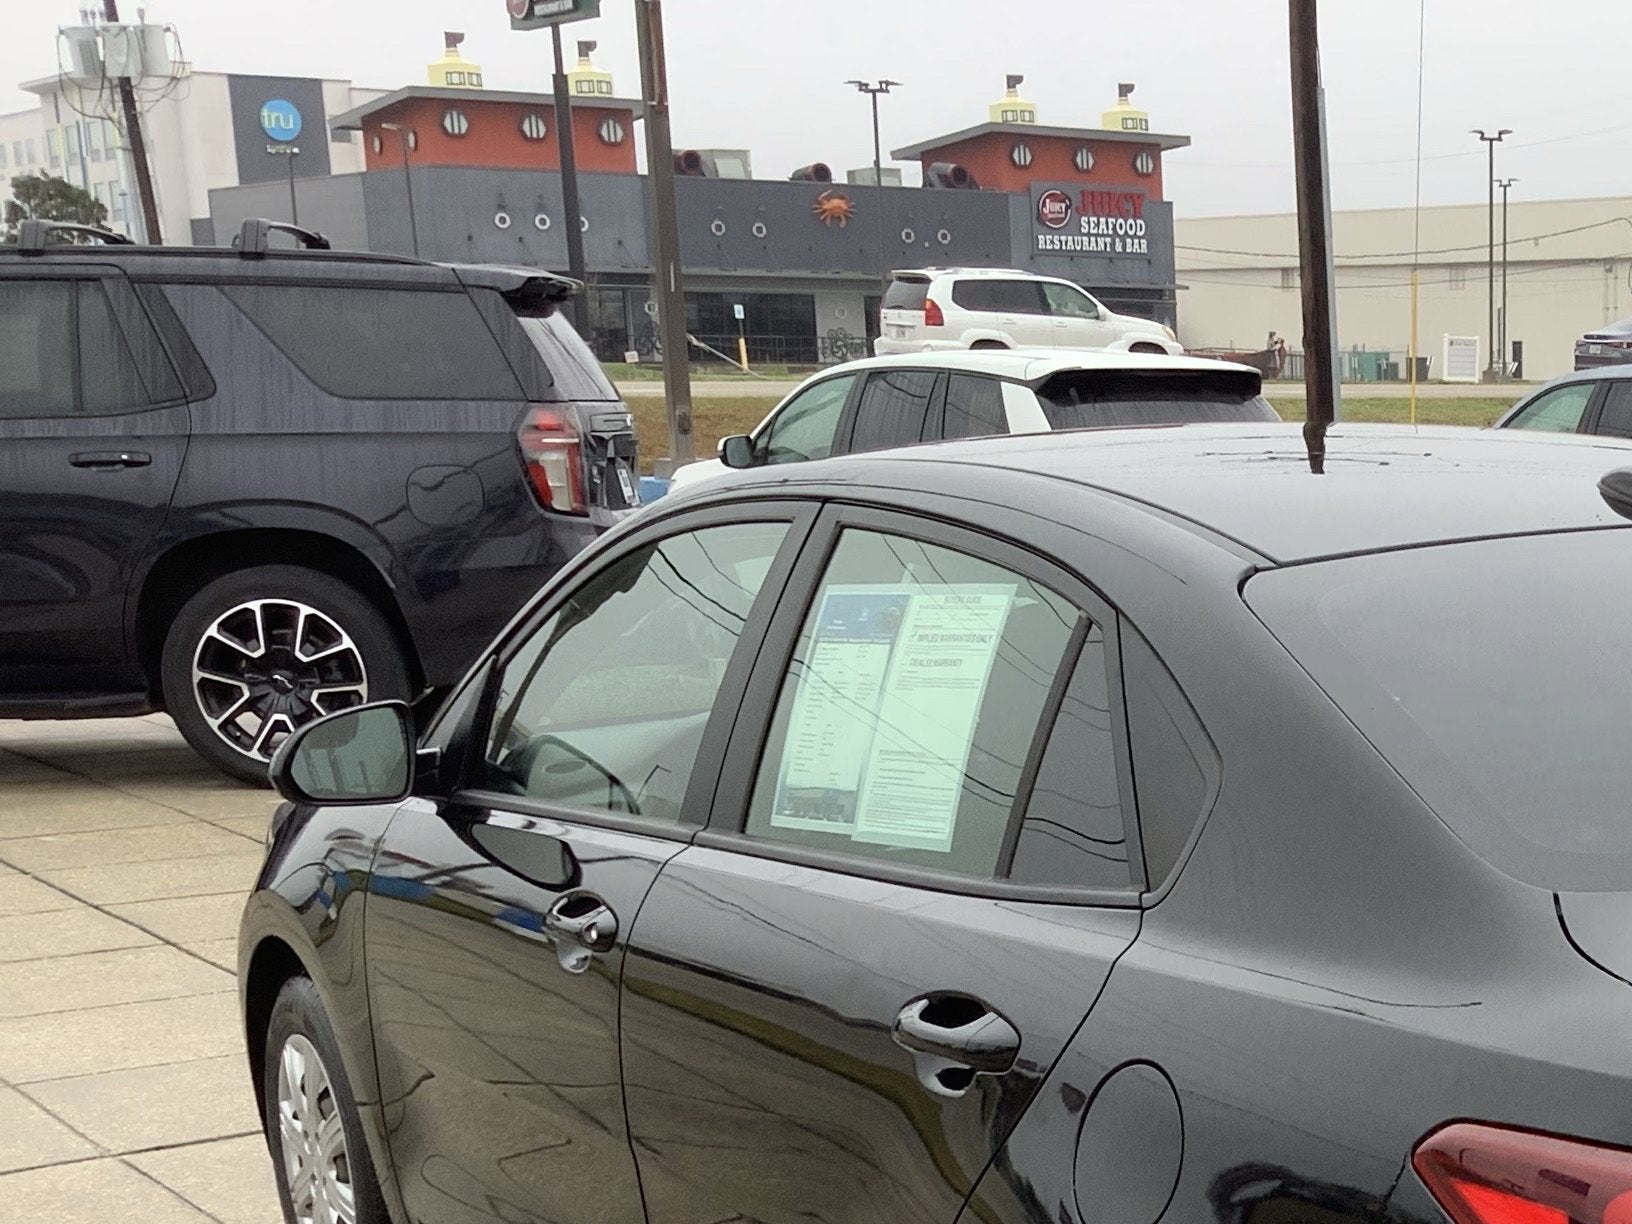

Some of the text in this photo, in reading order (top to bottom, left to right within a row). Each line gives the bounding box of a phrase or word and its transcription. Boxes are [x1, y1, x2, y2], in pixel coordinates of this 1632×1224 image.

[260, 108, 294, 129] tru
[1076, 190, 1144, 218] JUICY
[1081, 216, 1146, 236] SEAFOOD
[1038, 235, 1148, 253] RESTAURANT & BAR
